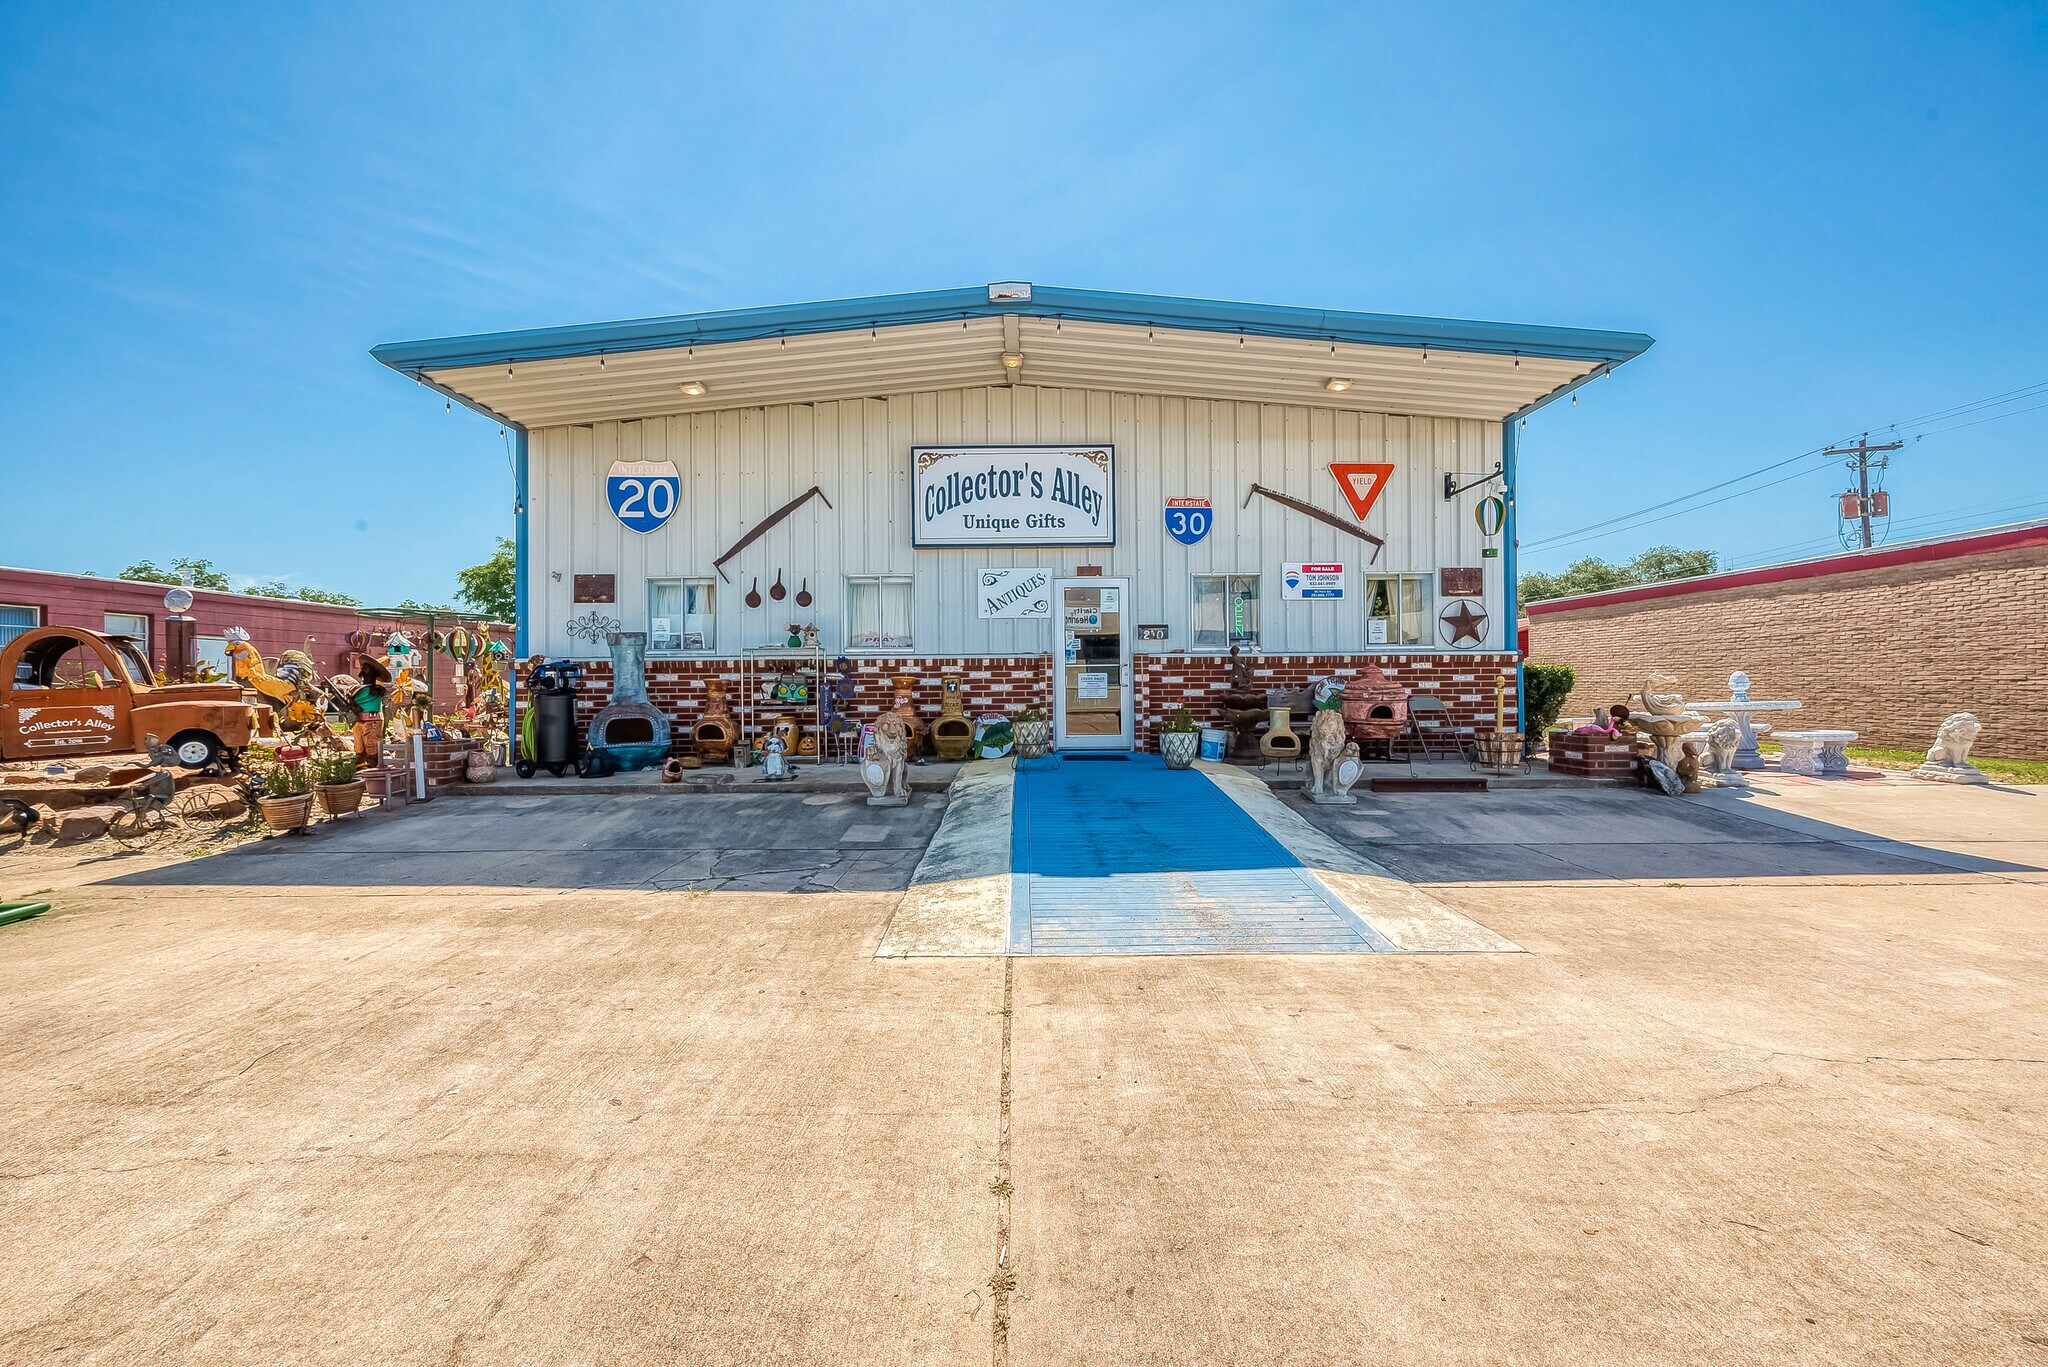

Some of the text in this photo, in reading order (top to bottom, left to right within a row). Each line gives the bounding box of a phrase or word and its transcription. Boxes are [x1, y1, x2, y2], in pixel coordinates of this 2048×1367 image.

[618, 465, 669, 475] INTERSTATE
[1352, 477, 1372, 485] YIELD
[618, 479, 674, 518] 20
[925, 462, 1103, 526] Collector's Alley
[963, 514, 1066, 532] Unique Gifts
[1171, 512, 1206, 535] 30
[986, 572, 1046, 615] ANTIQUES
[1233, 596, 1244, 637] OPEN
[19, 718, 115, 734] Collector's Alley
